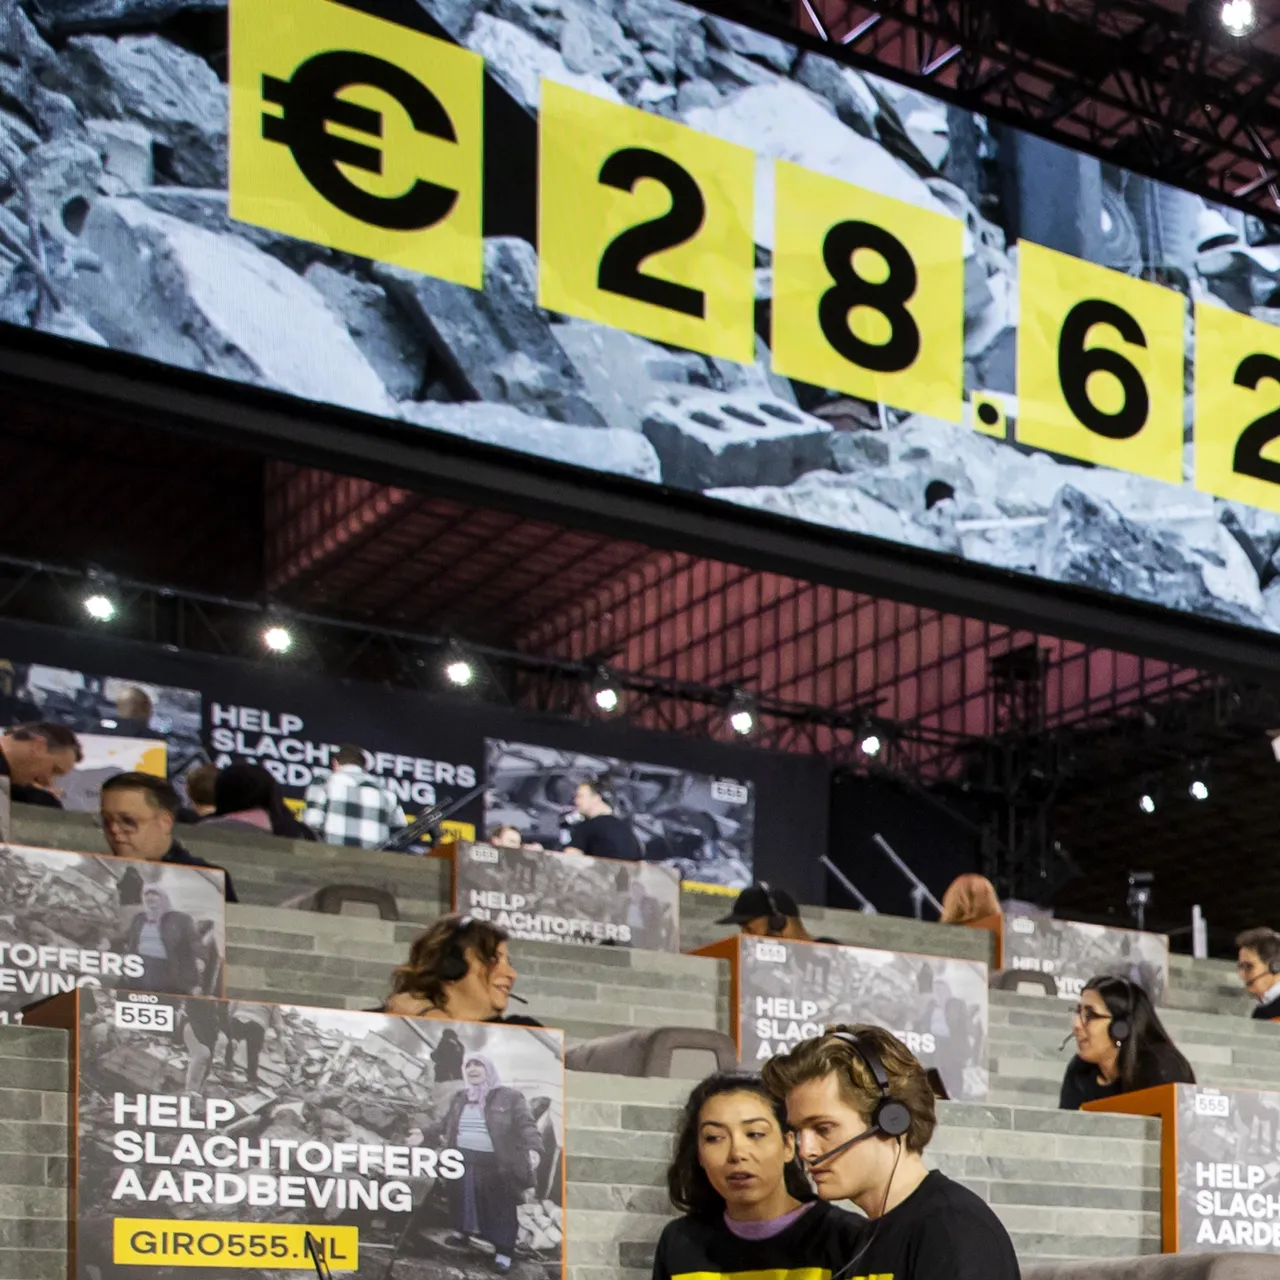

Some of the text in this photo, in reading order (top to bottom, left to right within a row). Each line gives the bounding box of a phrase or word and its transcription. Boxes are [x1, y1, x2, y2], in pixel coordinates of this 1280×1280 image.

[212, 702, 304, 736] HELP
[211, 727, 477, 788] SLACHFFERS
[470, 889, 526, 911] HELP
[128, 993, 159, 1004] GIRO
[755, 996, 818, 1020] HELP
[120, 1006, 169, 1027] 555
[755, 1017, 937, 1054] SLACERS
[114, 1091, 236, 1130] HELP
[112, 1129, 466, 1180] SLACHTOFFERS
[111, 1168, 413, 1213] AARDBEVING
[1195, 1161, 1266, 1190] HELP
[129, 1230, 348, 1261] GIRO555.NL
